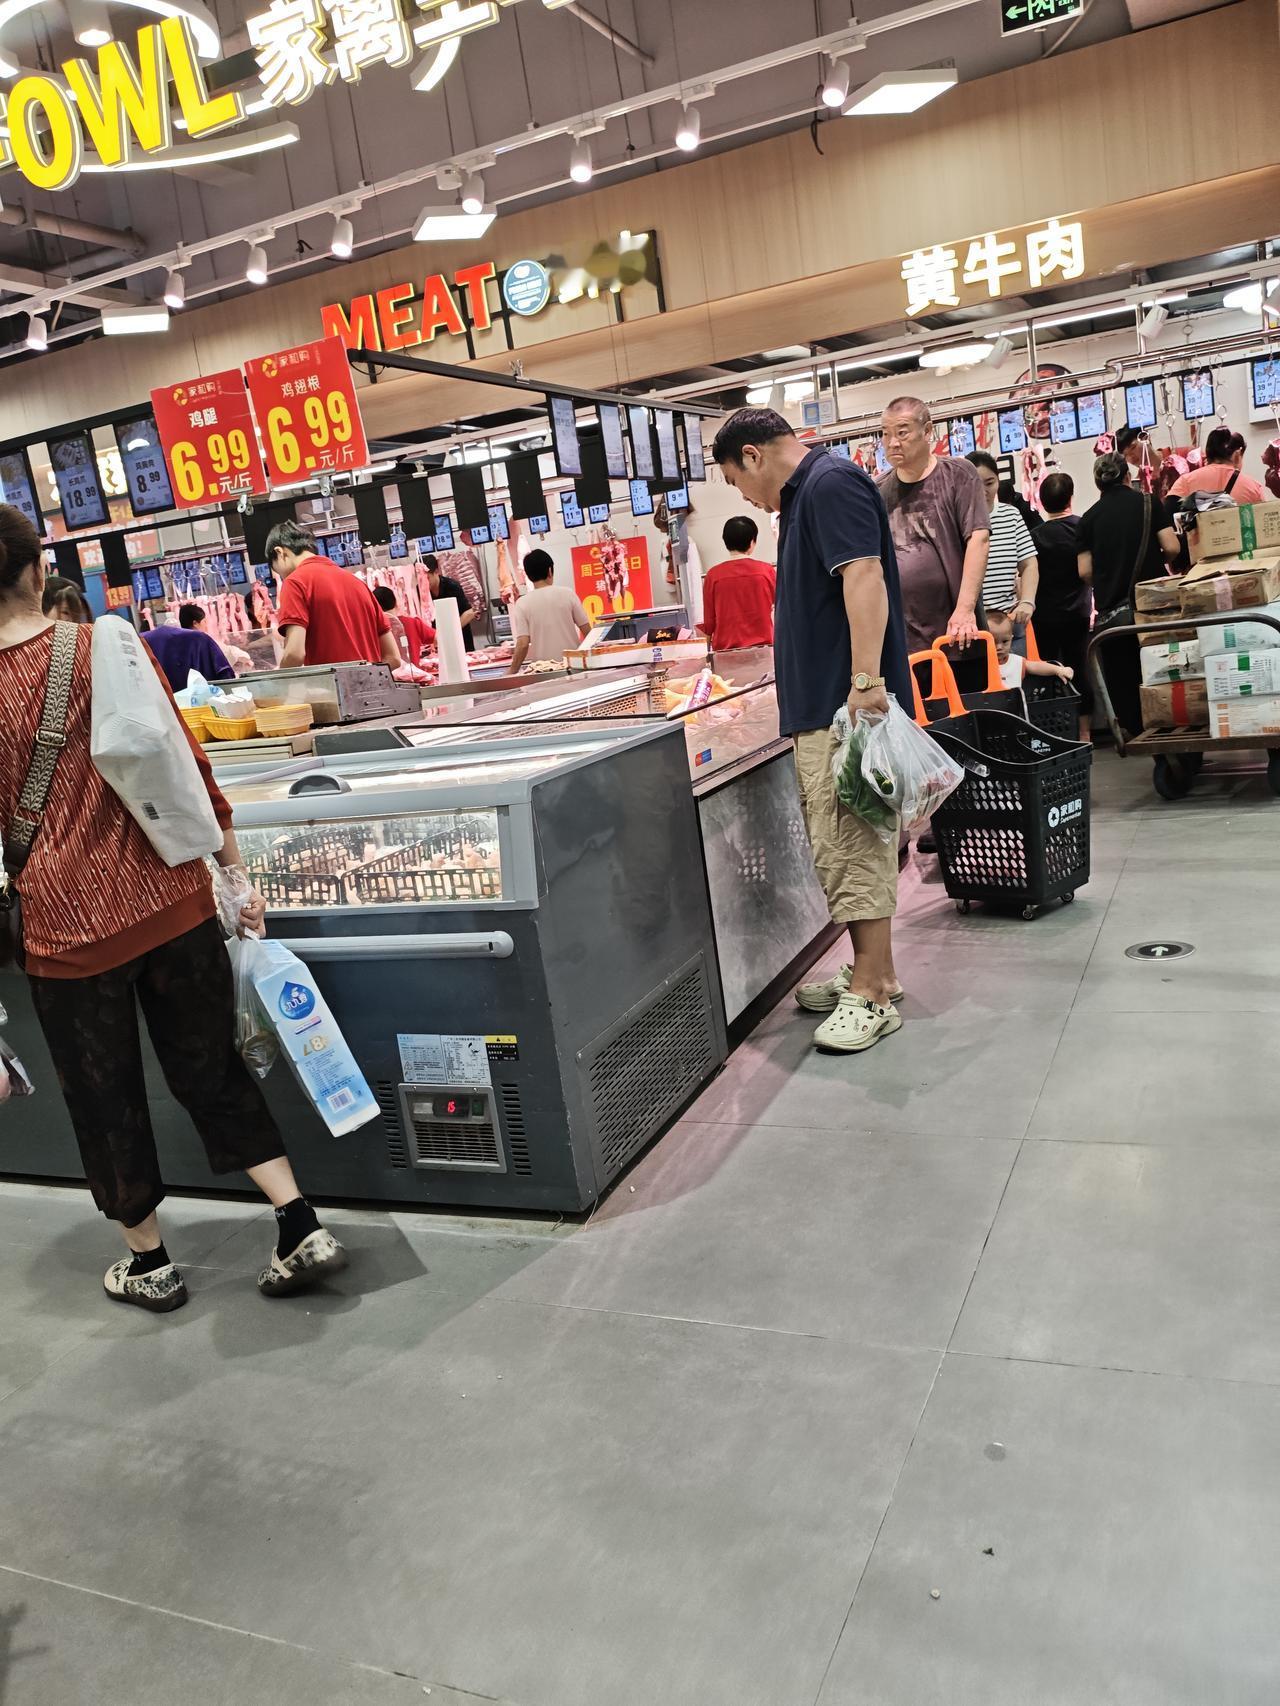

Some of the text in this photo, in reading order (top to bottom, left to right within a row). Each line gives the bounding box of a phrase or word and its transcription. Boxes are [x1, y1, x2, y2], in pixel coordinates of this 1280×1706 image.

[0, 15, 247, 191] OWL
[320, 262, 496, 352] MEAT
[901, 219, 1085, 316] 黄牛肉
[188, 407, 218, 428] 鸡腿
[281, 374, 321, 398] 鸡翅根
